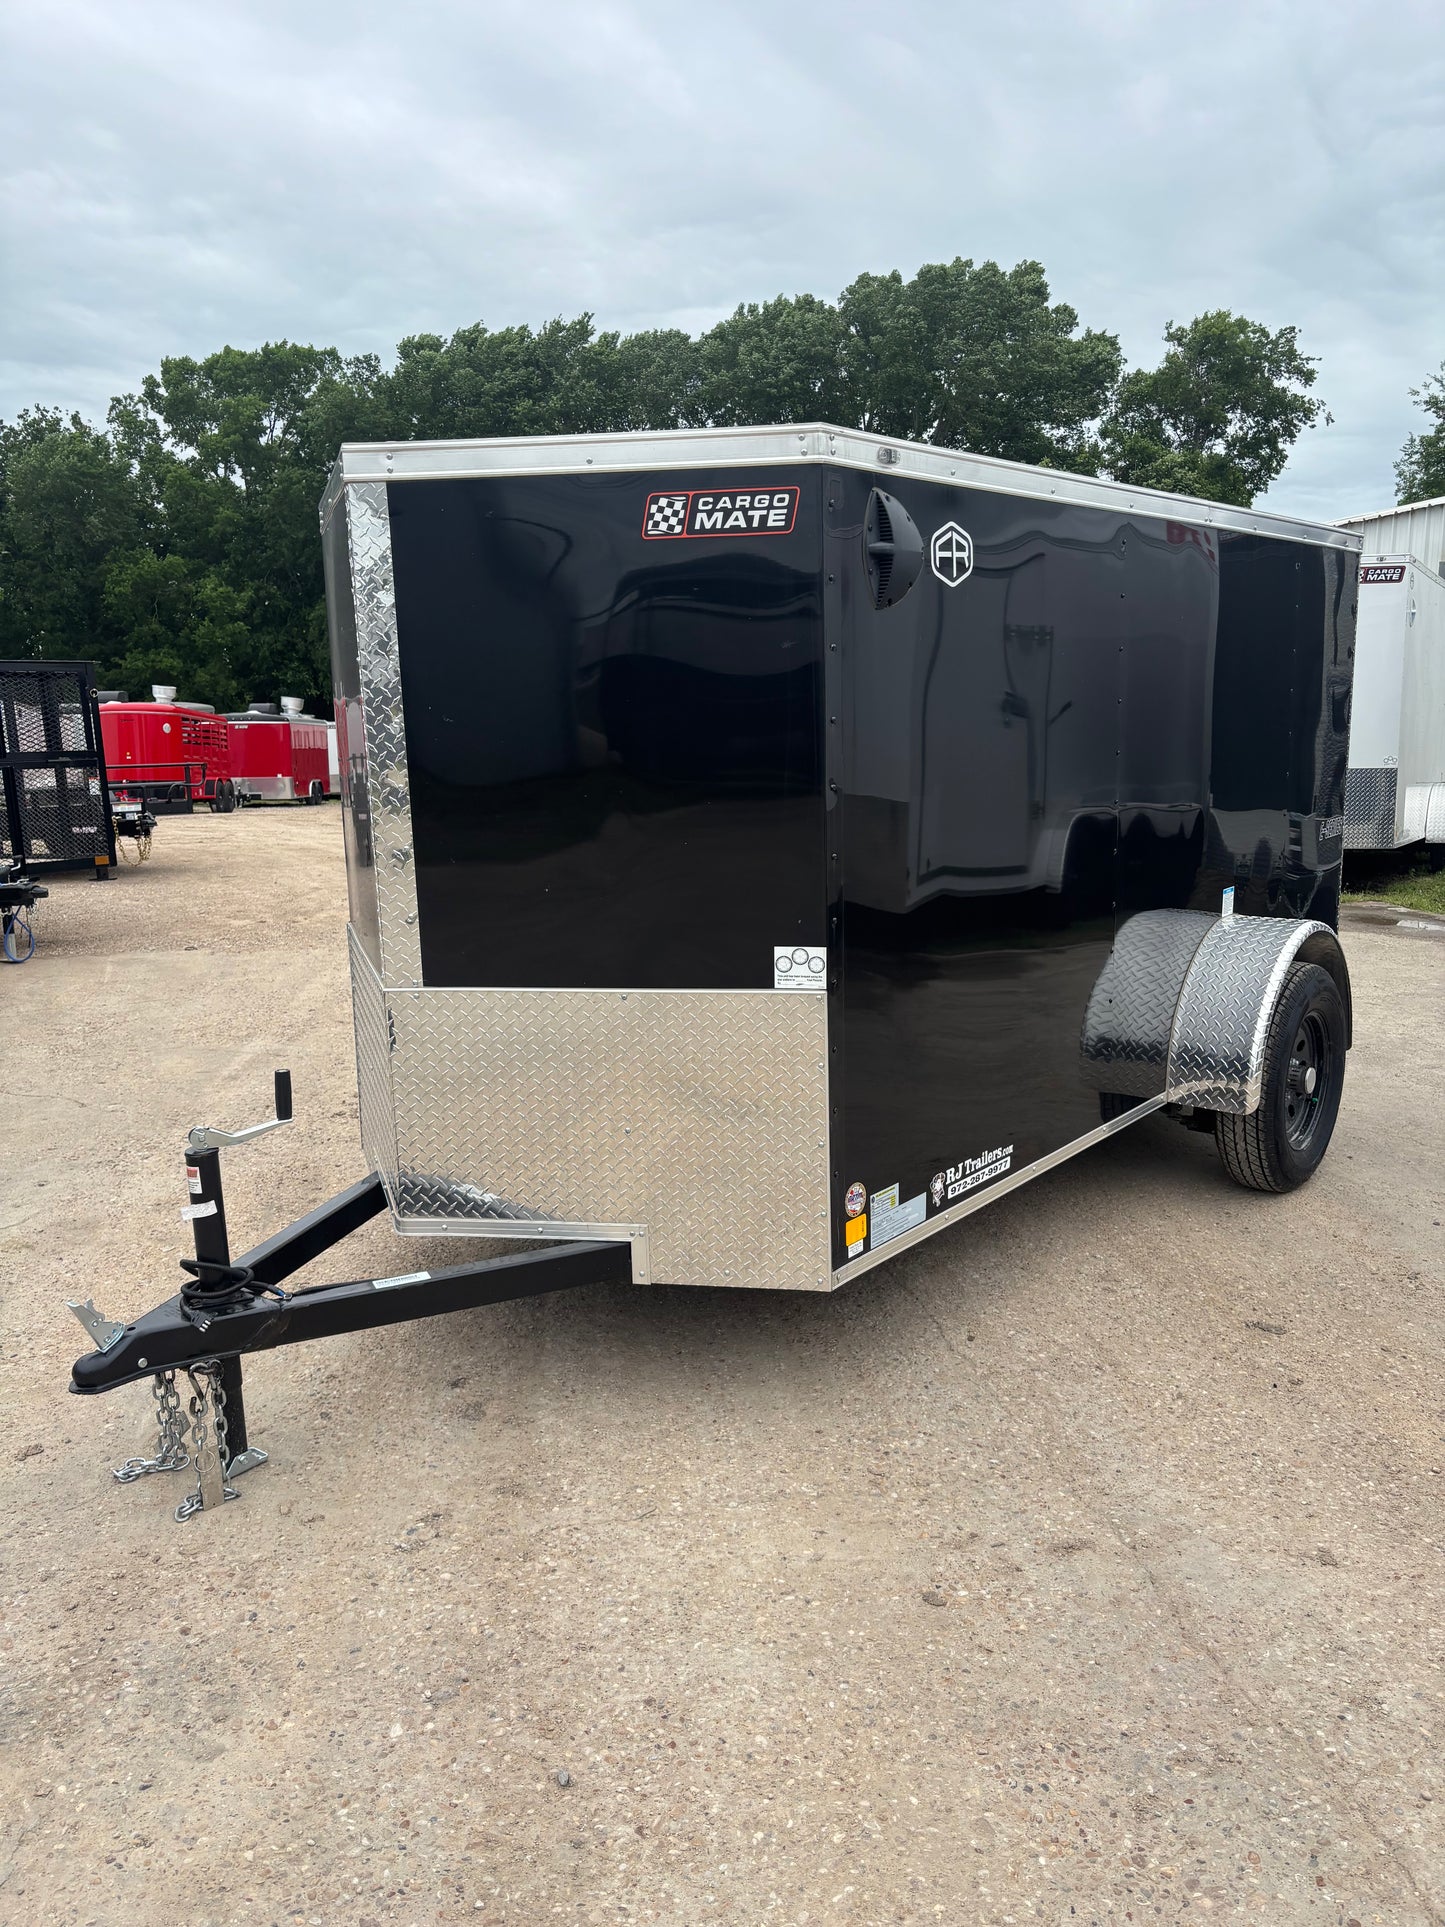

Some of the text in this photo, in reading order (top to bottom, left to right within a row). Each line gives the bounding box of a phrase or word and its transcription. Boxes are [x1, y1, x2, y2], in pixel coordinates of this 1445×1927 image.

[697, 493, 790, 510] CARGO
[694, 509, 788, 530] MATE
[945, 1162, 964, 1185] RJ
[950, 1160, 1008, 1195] 972-287-9977
